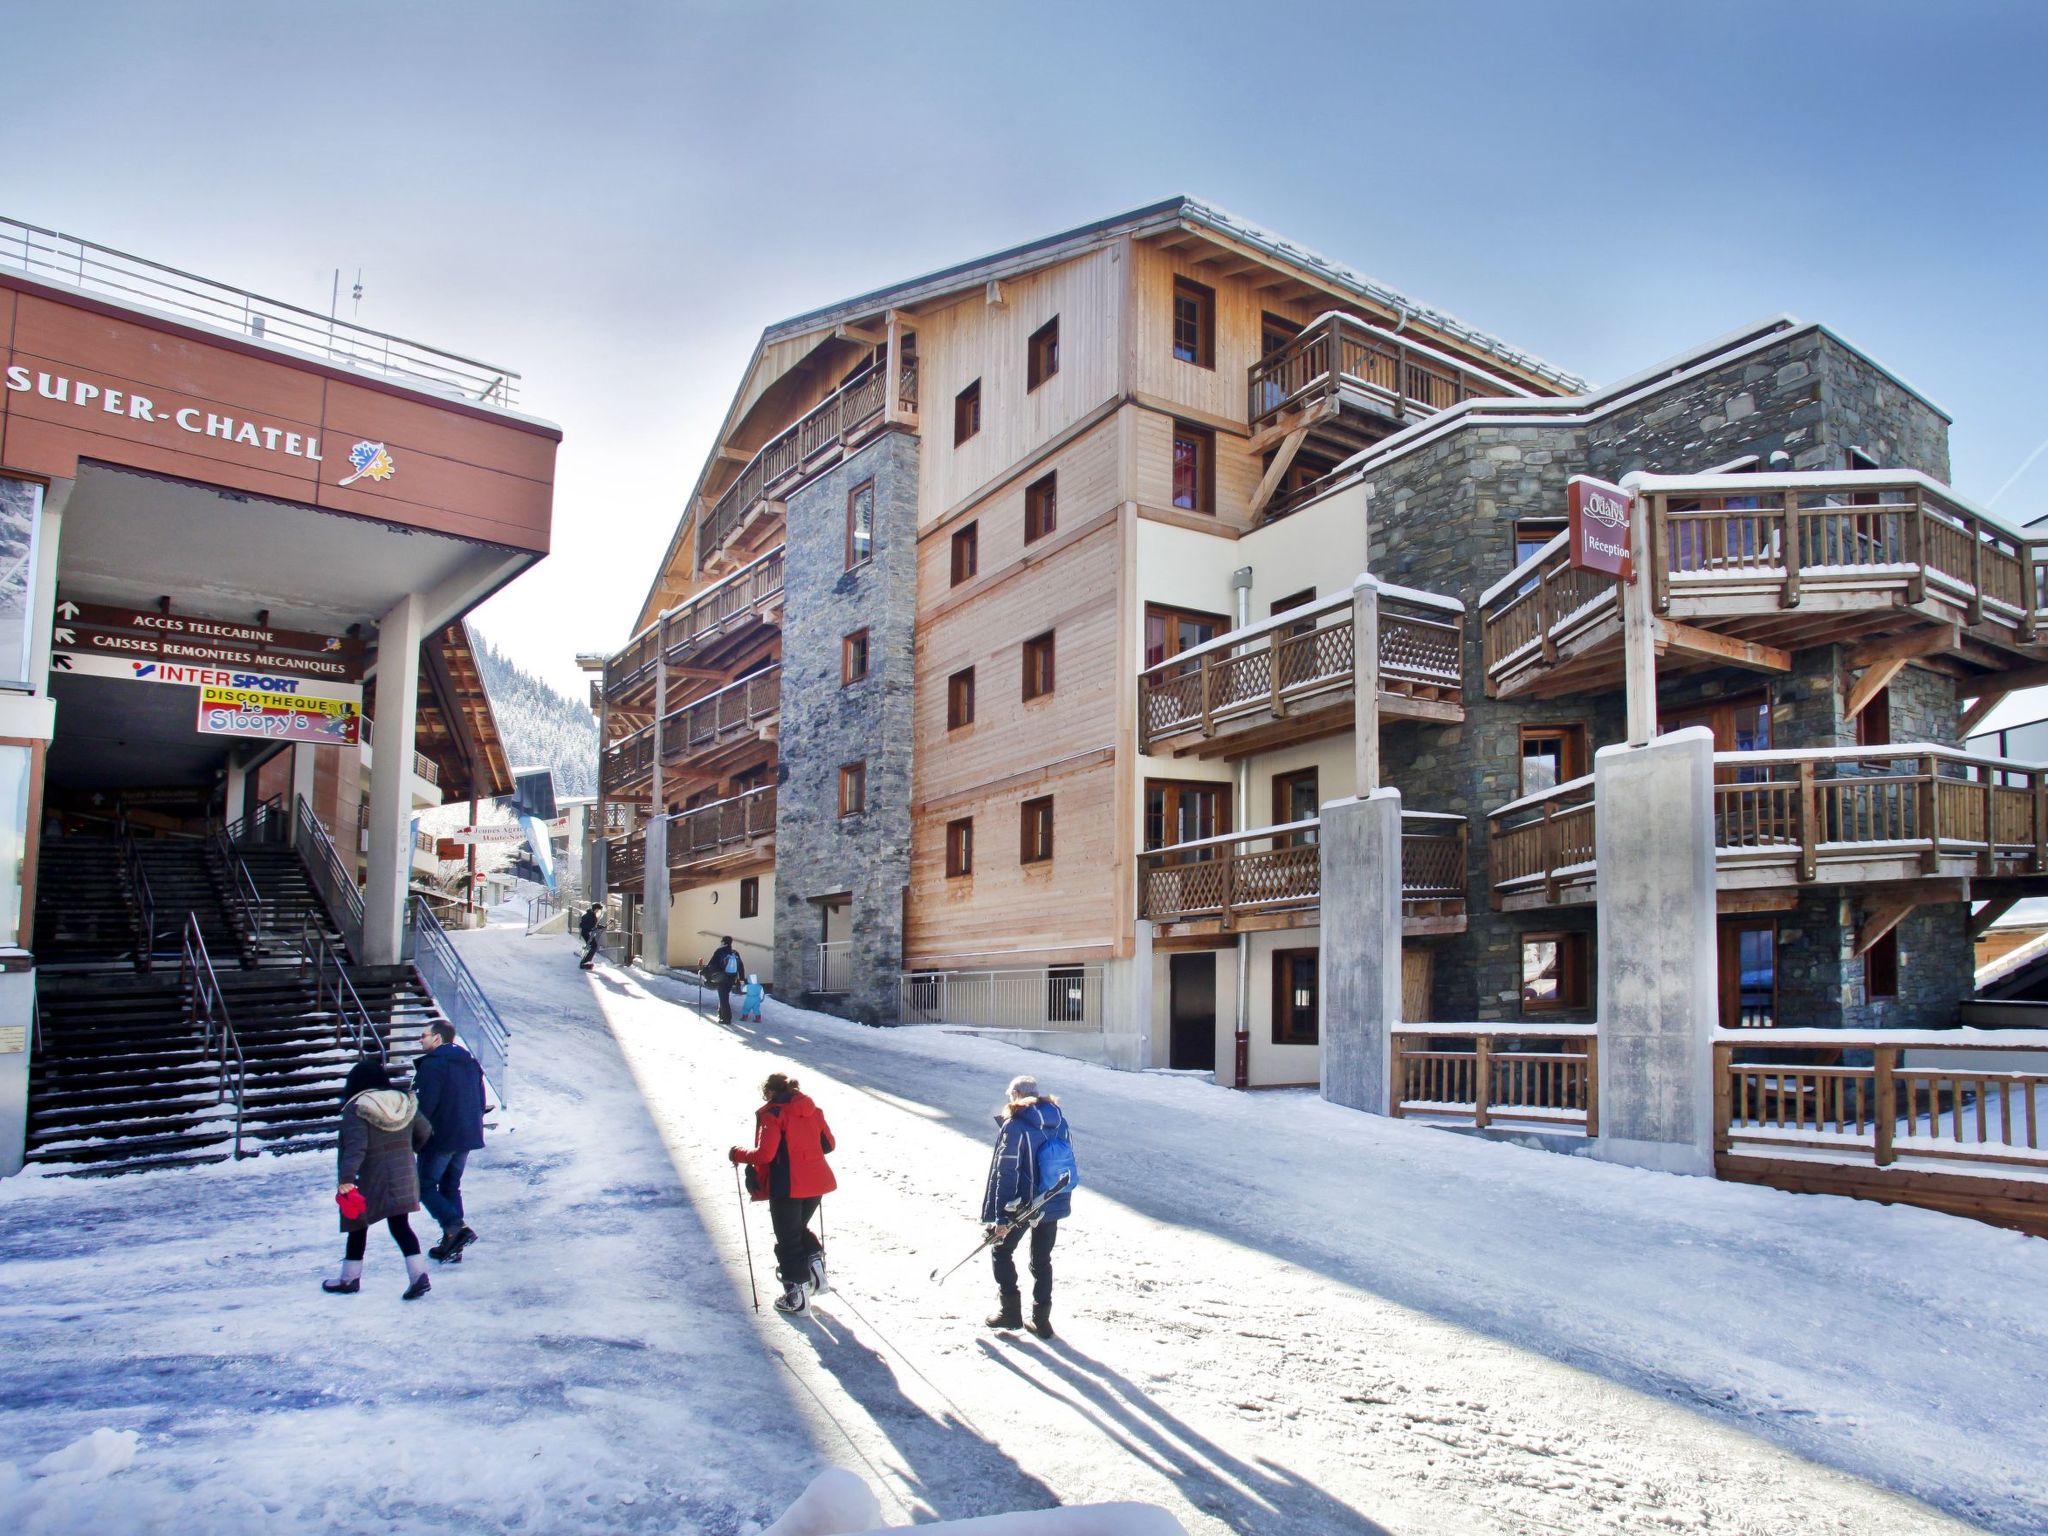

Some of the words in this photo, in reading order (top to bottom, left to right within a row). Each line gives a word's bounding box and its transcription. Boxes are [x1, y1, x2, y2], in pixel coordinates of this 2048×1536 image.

[5, 366, 323, 461] SUPER-CHATEL
[1588, 493, 1626, 522] Odalys
[1589, 536, 1630, 559] Réception
[133, 615, 184, 631] ACCES
[188, 622, 274, 642] TELECABINE
[92, 635, 158, 652] CAISSES
[163, 643, 251, 663] REMONTEES
[255, 654, 346, 674] MECANIQUES
[159, 664, 299, 693] INTERSPORT
[205, 689, 328, 711] DISCOTHEQUE
[242, 701, 263, 714] Le
[209, 708, 309, 736] Sloopy's
